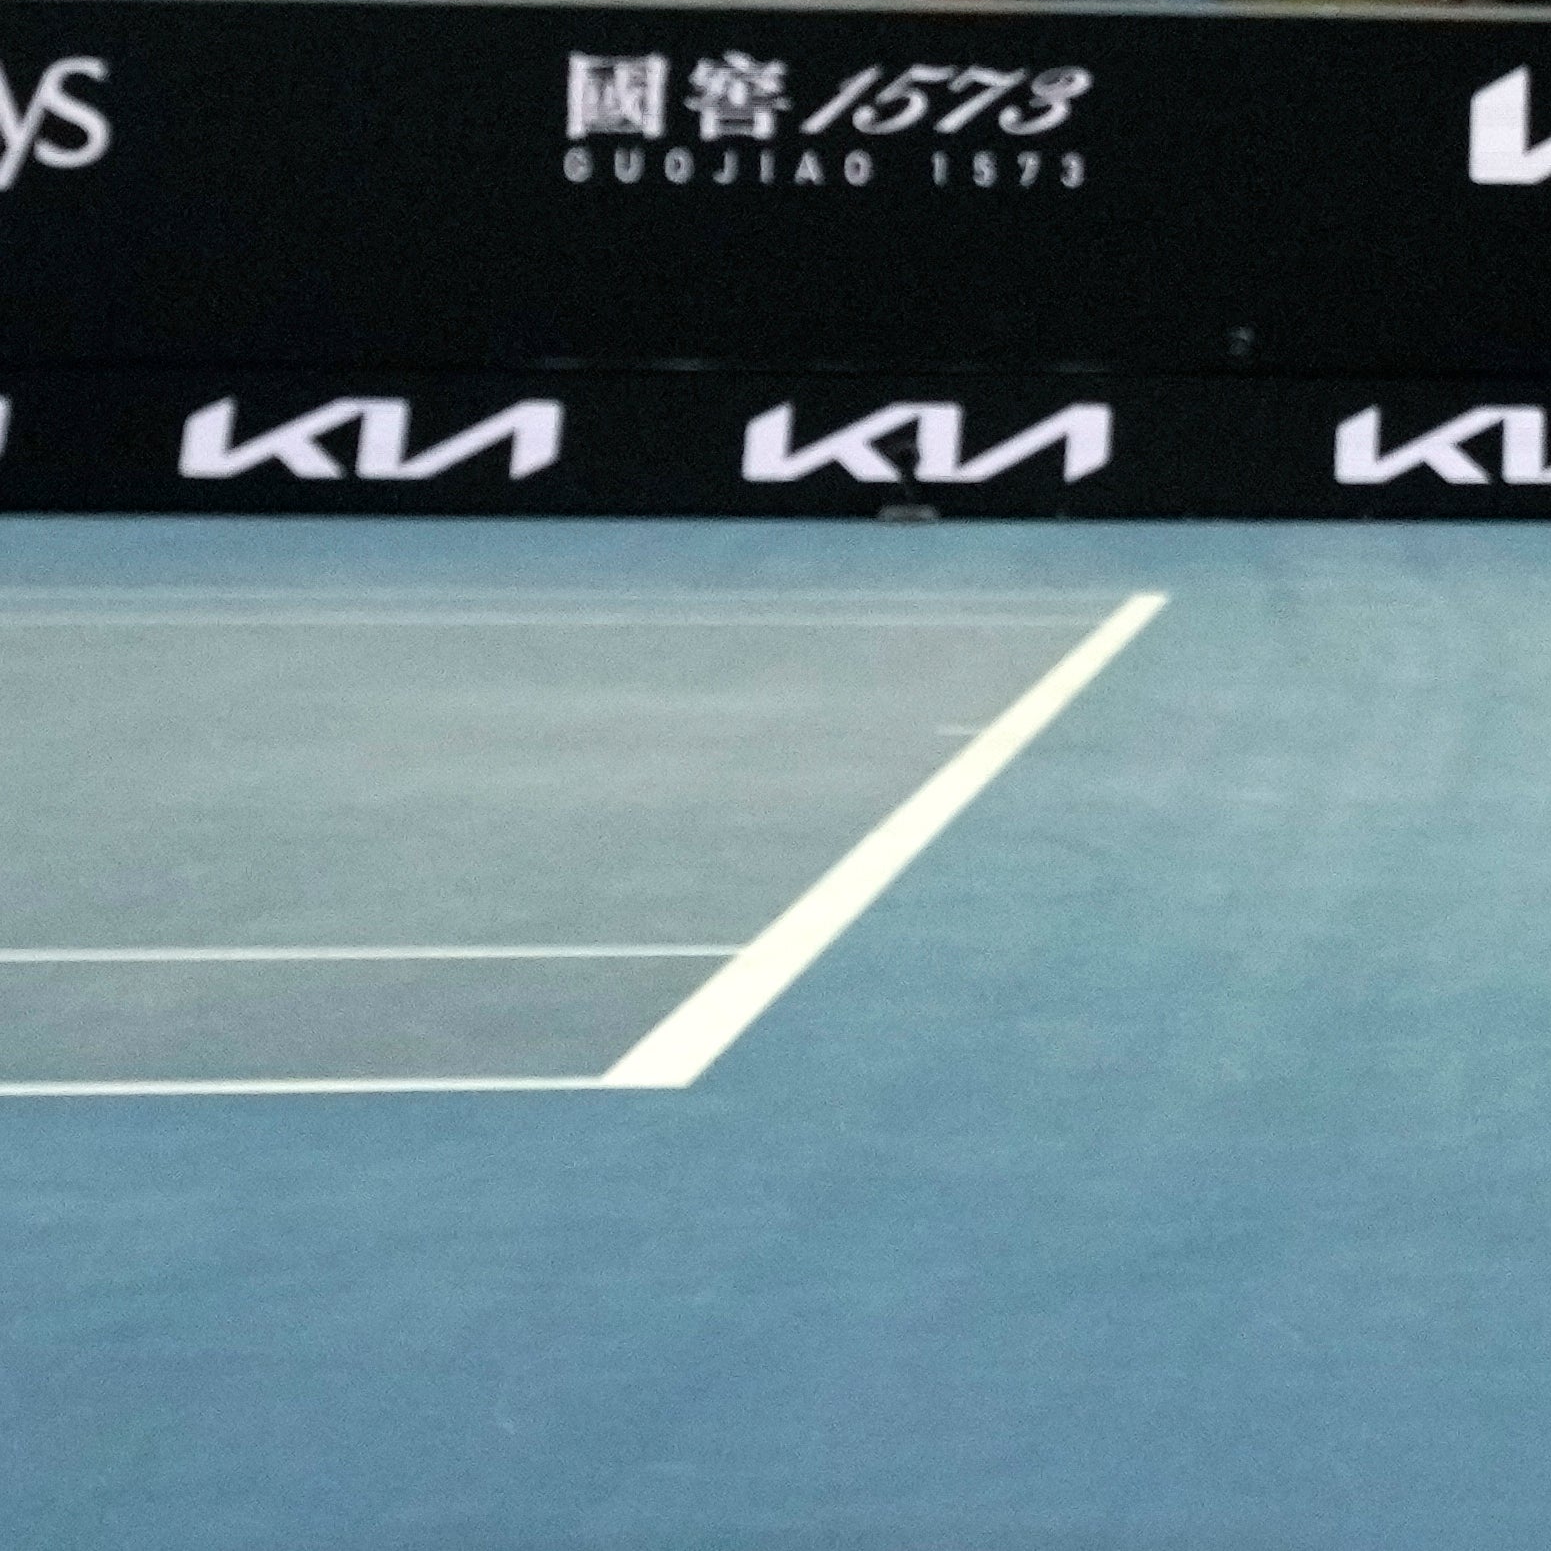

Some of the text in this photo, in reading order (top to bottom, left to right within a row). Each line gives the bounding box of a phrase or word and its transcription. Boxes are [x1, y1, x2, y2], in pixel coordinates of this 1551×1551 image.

[800, 64, 1093, 137] 1573
[563, 146, 1086, 189] GUOJIAO 1573
